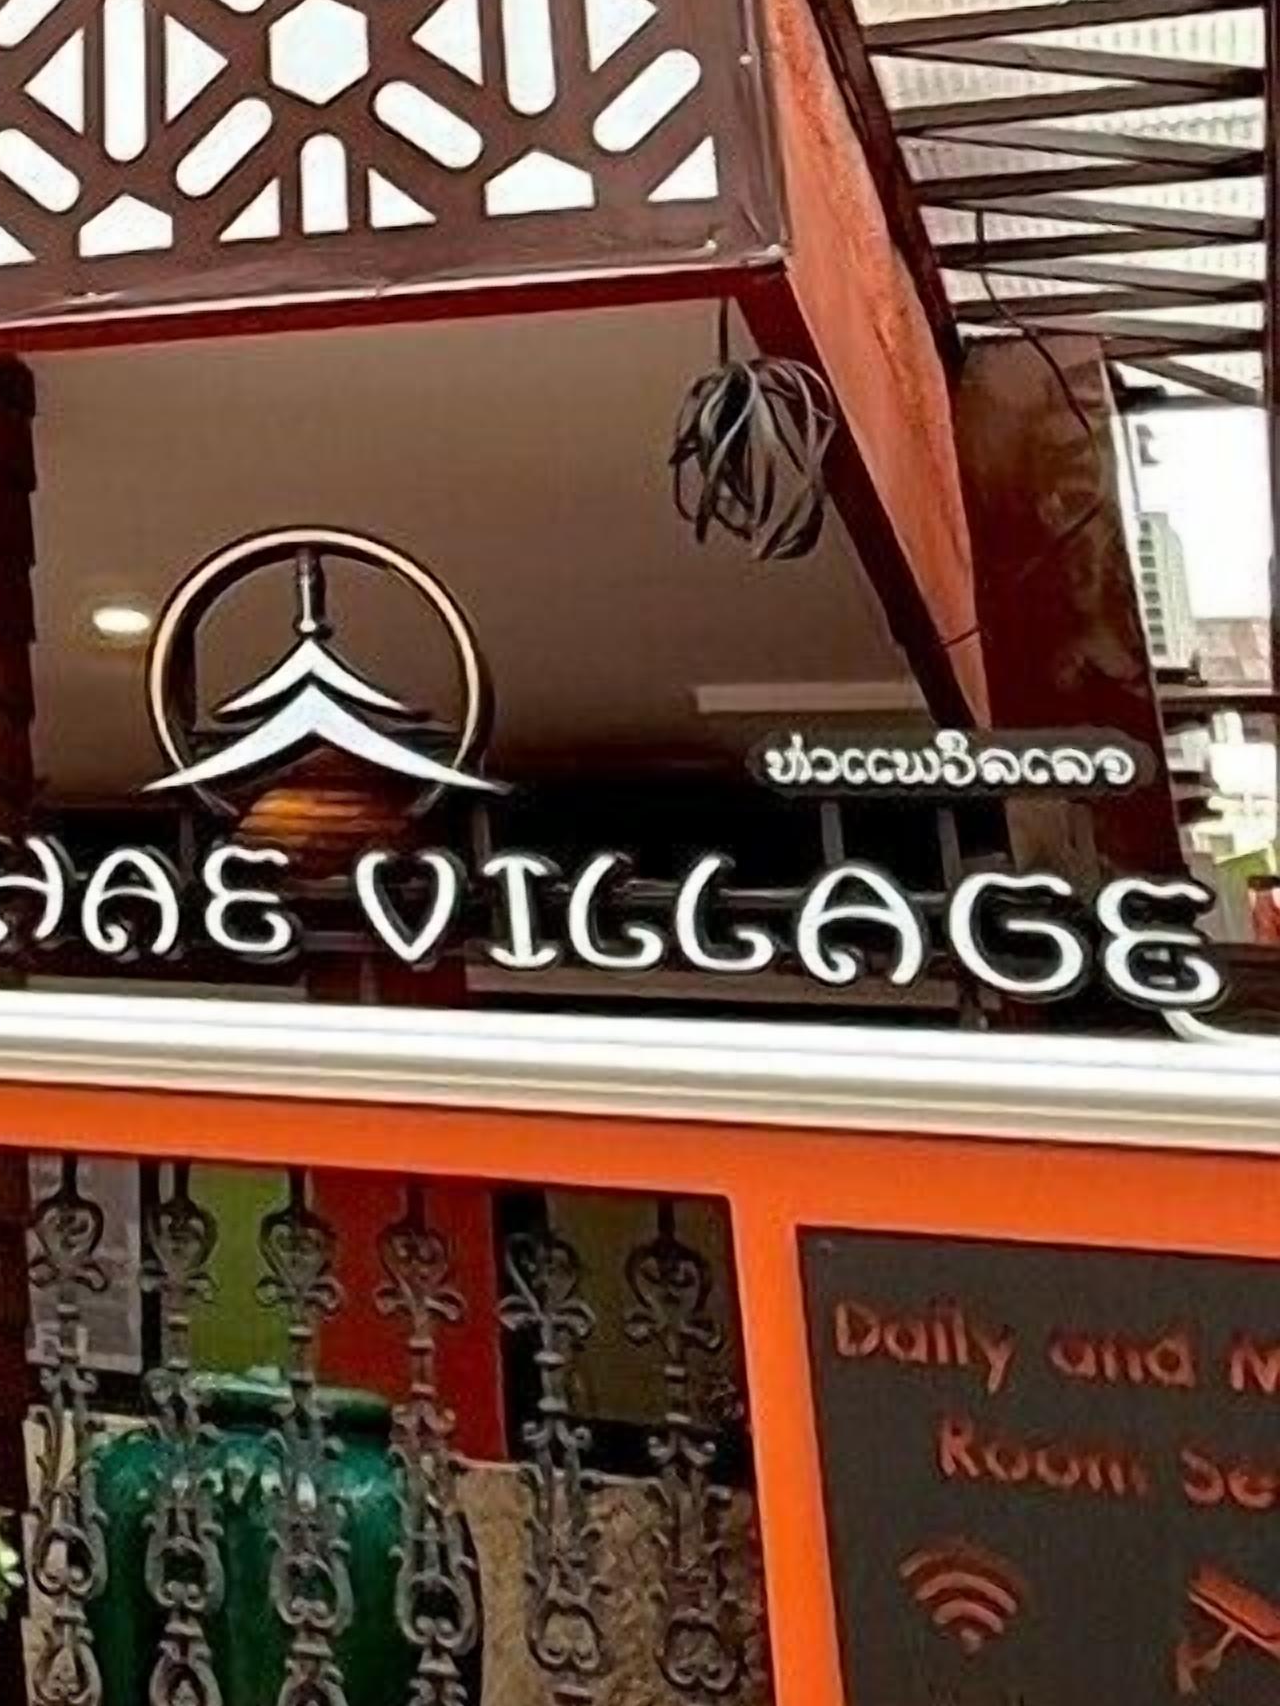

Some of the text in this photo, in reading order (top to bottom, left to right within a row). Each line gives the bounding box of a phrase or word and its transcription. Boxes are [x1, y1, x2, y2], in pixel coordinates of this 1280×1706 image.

[355, 851, 1222, 1005] VILLAGE
[835, 1299, 1017, 1394] Daily
[1050, 1326, 1196, 1388] and
[939, 1413, 1152, 1496] Room
